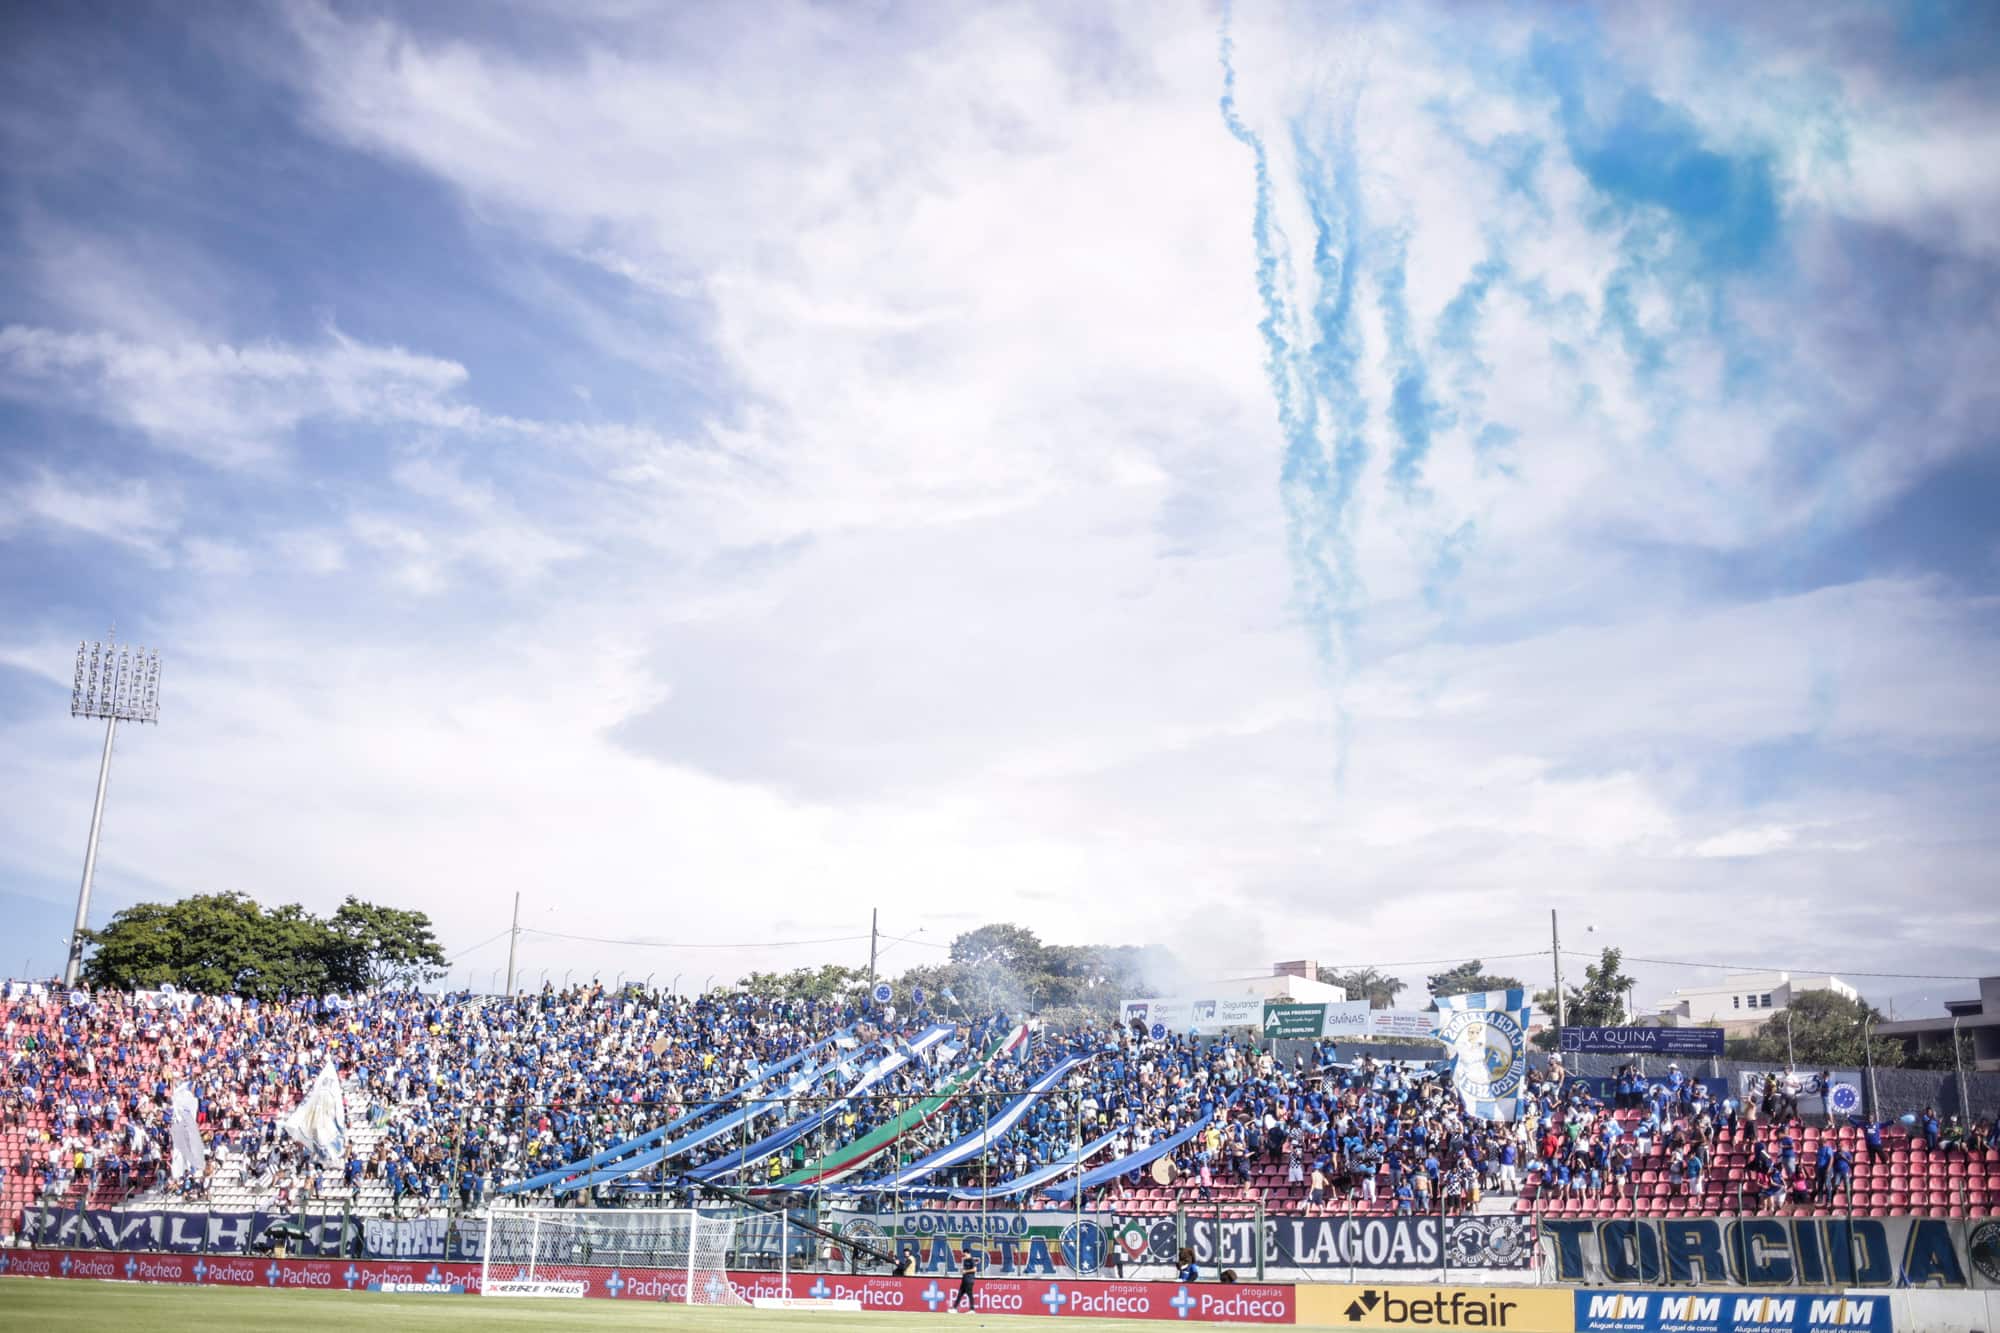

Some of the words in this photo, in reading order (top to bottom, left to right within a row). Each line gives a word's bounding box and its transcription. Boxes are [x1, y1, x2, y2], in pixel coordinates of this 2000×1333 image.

[1604, 1030, 1656, 1044] QUINA
[902, 1214, 1029, 1235] COMANDO
[367, 1219, 445, 1256] GERAL
[1193, 1219, 1278, 1265] SETE
[1291, 1219, 1437, 1265] LAGOAS
[896, 1233, 1057, 1275] RASTA
[1540, 1219, 1968, 1287] TORCIDA
[11, 1257, 50, 1273] Pacheco
[73, 1258, 114, 1275] Pacheco
[139, 1261, 182, 1278] Pacheco
[208, 1263, 254, 1281] Pacheco
[282, 1266, 331, 1285] Pacheco
[396, 1283, 452, 1292] GERDAU
[543, 1285, 581, 1294] PNEUS
[627, 1276, 688, 1298] Pacheco
[834, 1284, 904, 1306] Pacheco
[1109, 1284, 1148, 1294] drogarias
[1242, 1287, 1282, 1298] drogarias
[1071, 1290, 1150, 1313] Pacheco
[1201, 1293, 1285, 1317] Pacheco
[1384, 1290, 1518, 1327] betfair
